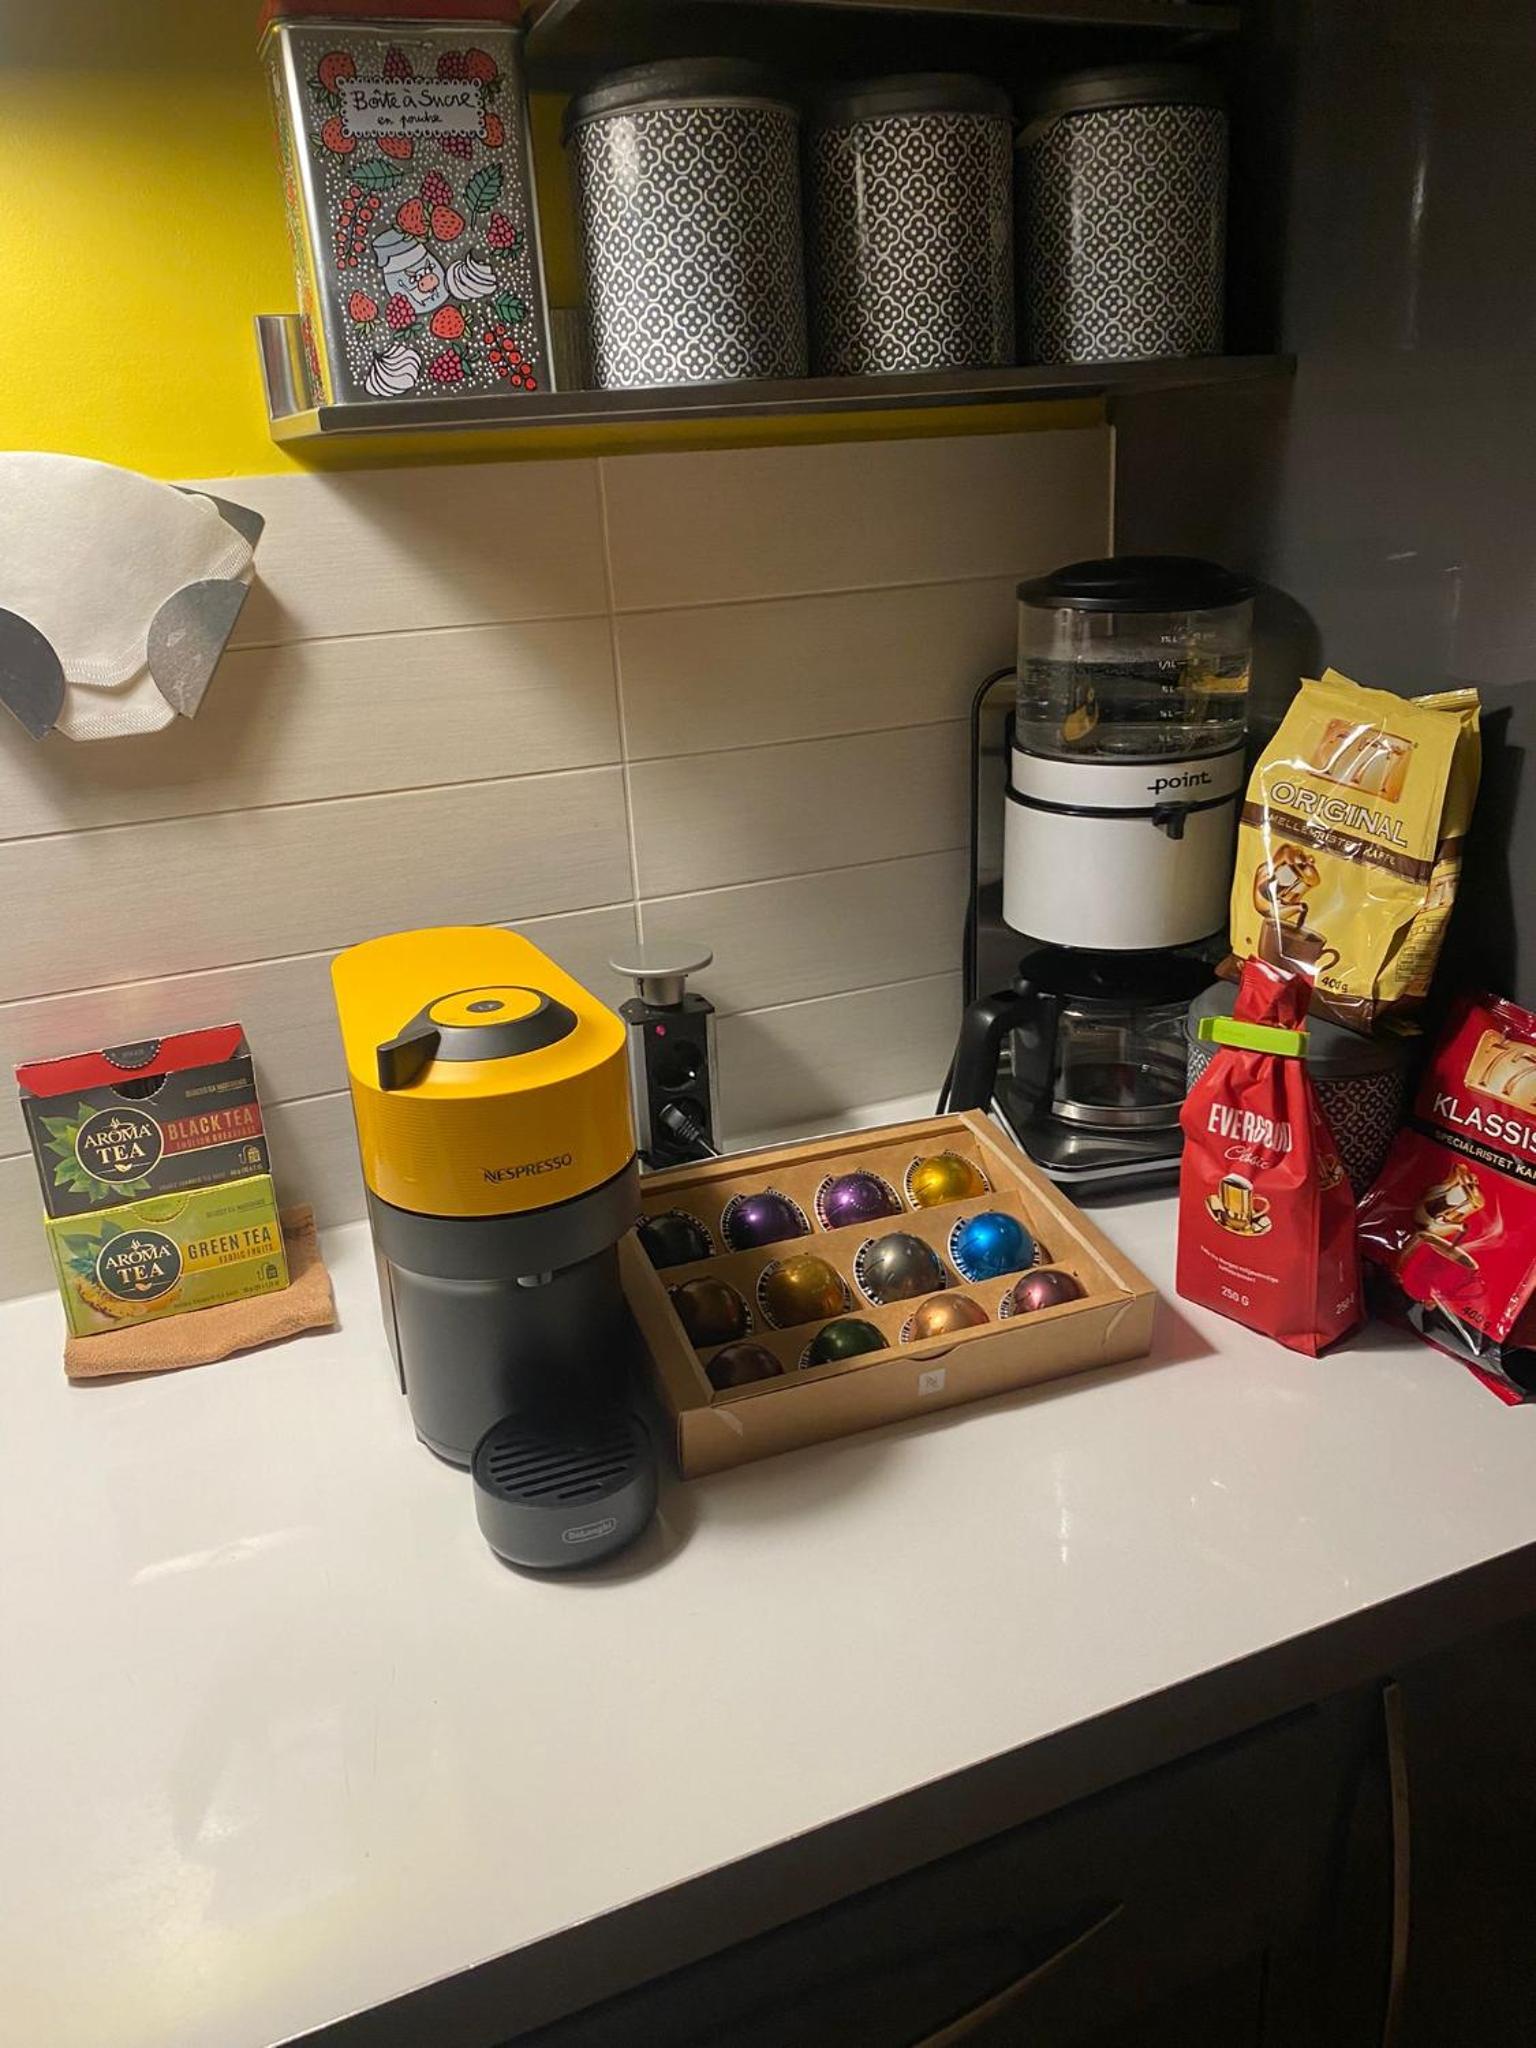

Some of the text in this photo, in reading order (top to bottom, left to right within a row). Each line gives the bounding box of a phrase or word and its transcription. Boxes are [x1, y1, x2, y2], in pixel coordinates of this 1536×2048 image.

[403, 88, 417, 108] à
[420, 89, 476, 109] Sucre
[377, 114, 394, 126] en
[1147, 771, 1212, 796] point
[1270, 781, 1408, 849] ORIGINAL
[84, 1123, 152, 1150] AROMA
[168, 1107, 254, 1142] BLACK TEA
[96, 1142, 147, 1165] TEA
[484, 1152, 573, 1184] NESPRESSO
[188, 1226, 272, 1260] GREEN TEA
[104, 1246, 172, 1270] AROMA
[116, 1263, 165, 1284] TEA
[1221, 1286, 1250, 1307] 250 G
[1462, 1306, 1483, 1324] 400
